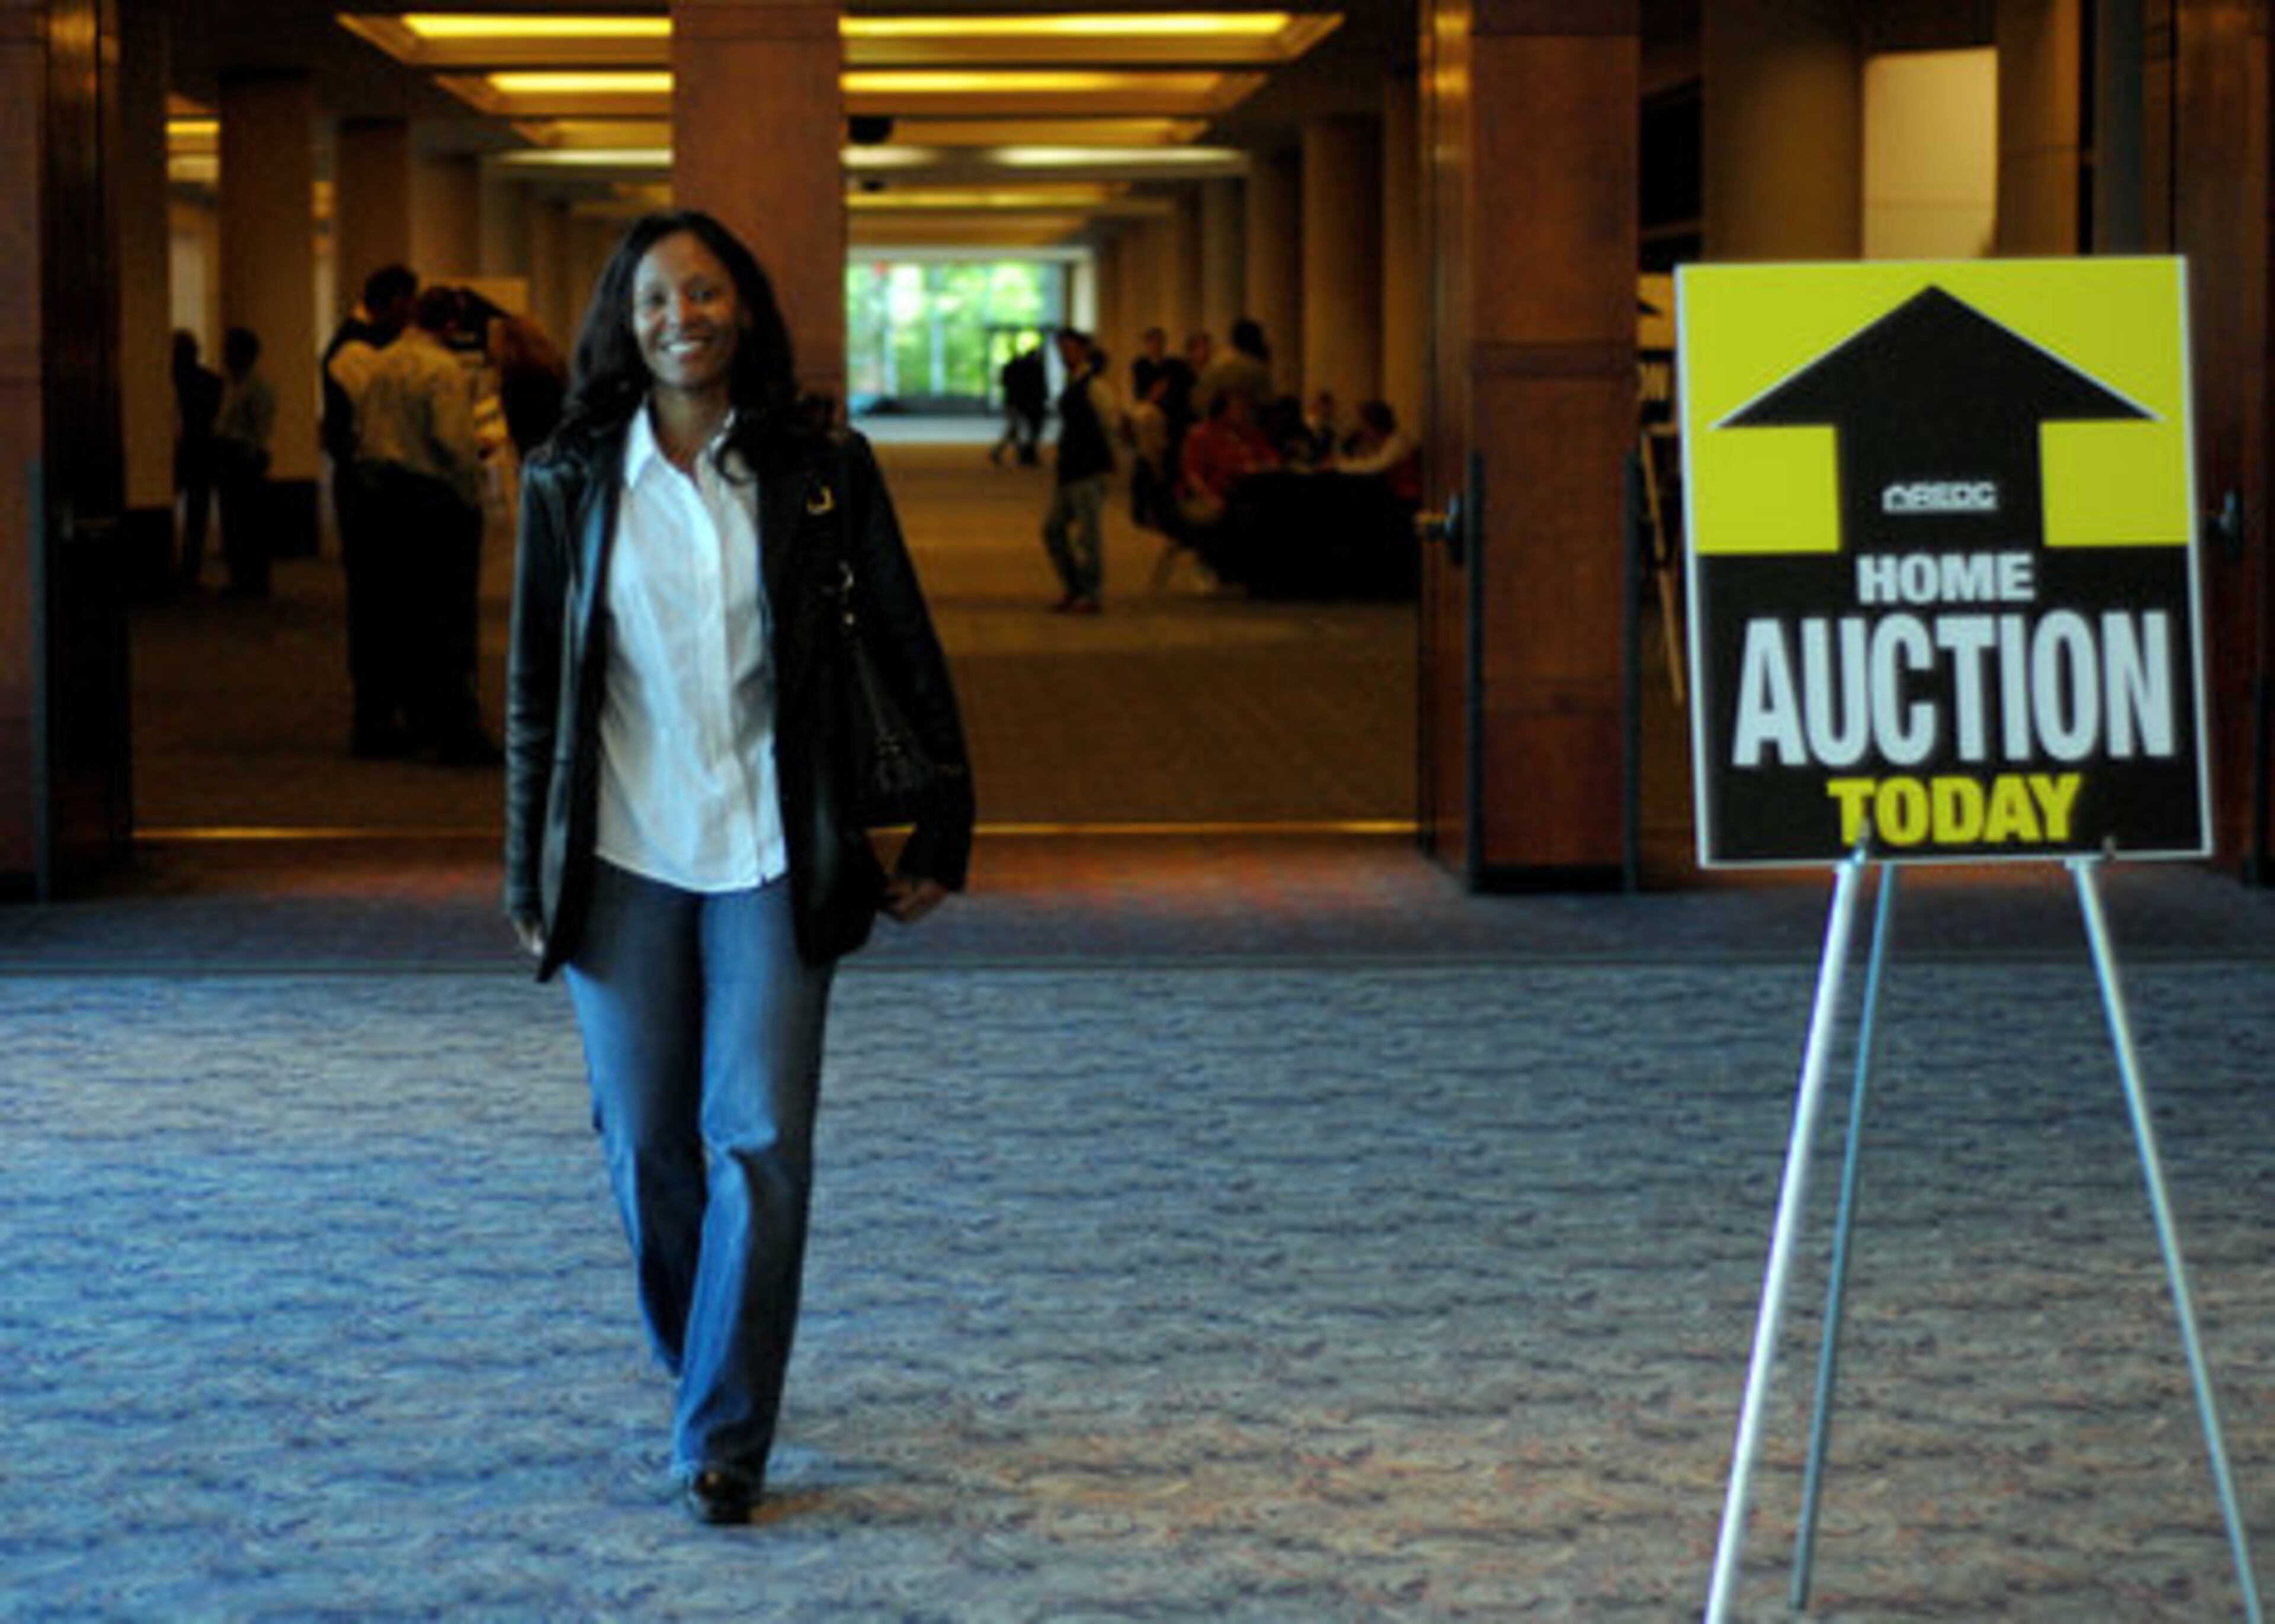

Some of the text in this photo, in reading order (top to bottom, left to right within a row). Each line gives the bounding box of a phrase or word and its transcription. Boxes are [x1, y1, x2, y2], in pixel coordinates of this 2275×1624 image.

[1857, 552, 2035, 604] HOME
[1732, 609, 2174, 768] AUCTION
[1827, 774, 2081, 847] TODAY
